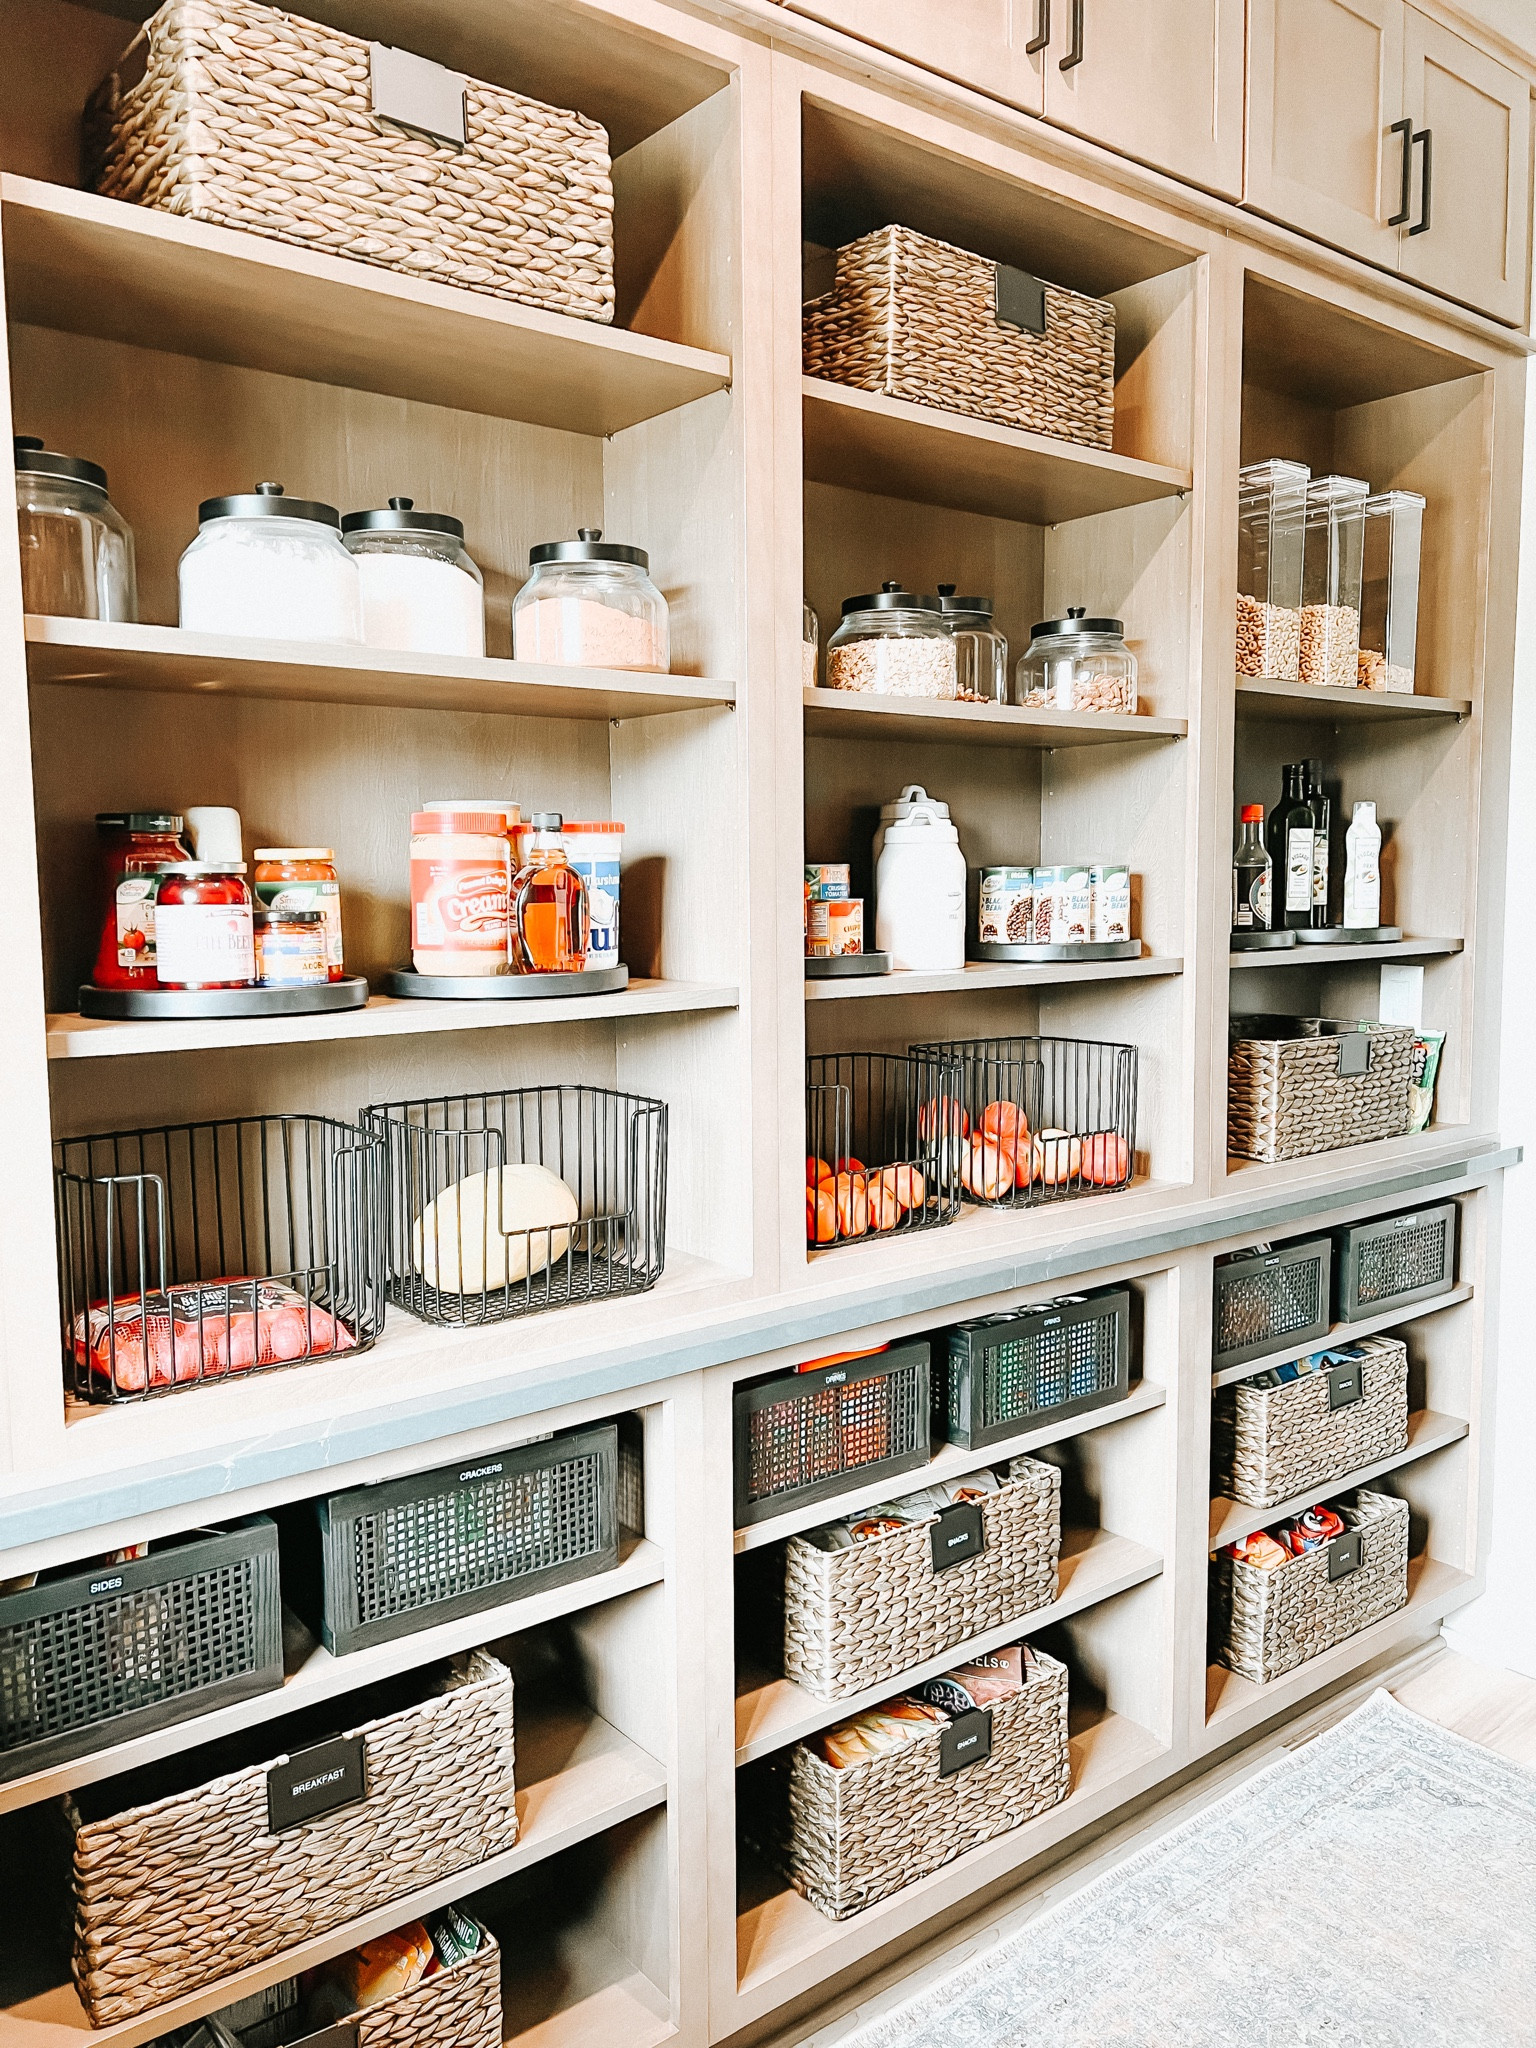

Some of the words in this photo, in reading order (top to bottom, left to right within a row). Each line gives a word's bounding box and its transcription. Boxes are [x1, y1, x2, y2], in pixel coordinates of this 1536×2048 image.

[459, 1463, 503, 1481] CRACKERS
[947, 1533, 969, 1547] SNACKS
[90, 1577, 123, 1594] SIDES
[957, 1735, 978, 1750] SNACKS
[292, 1768, 345, 1796] BREAKFAST
